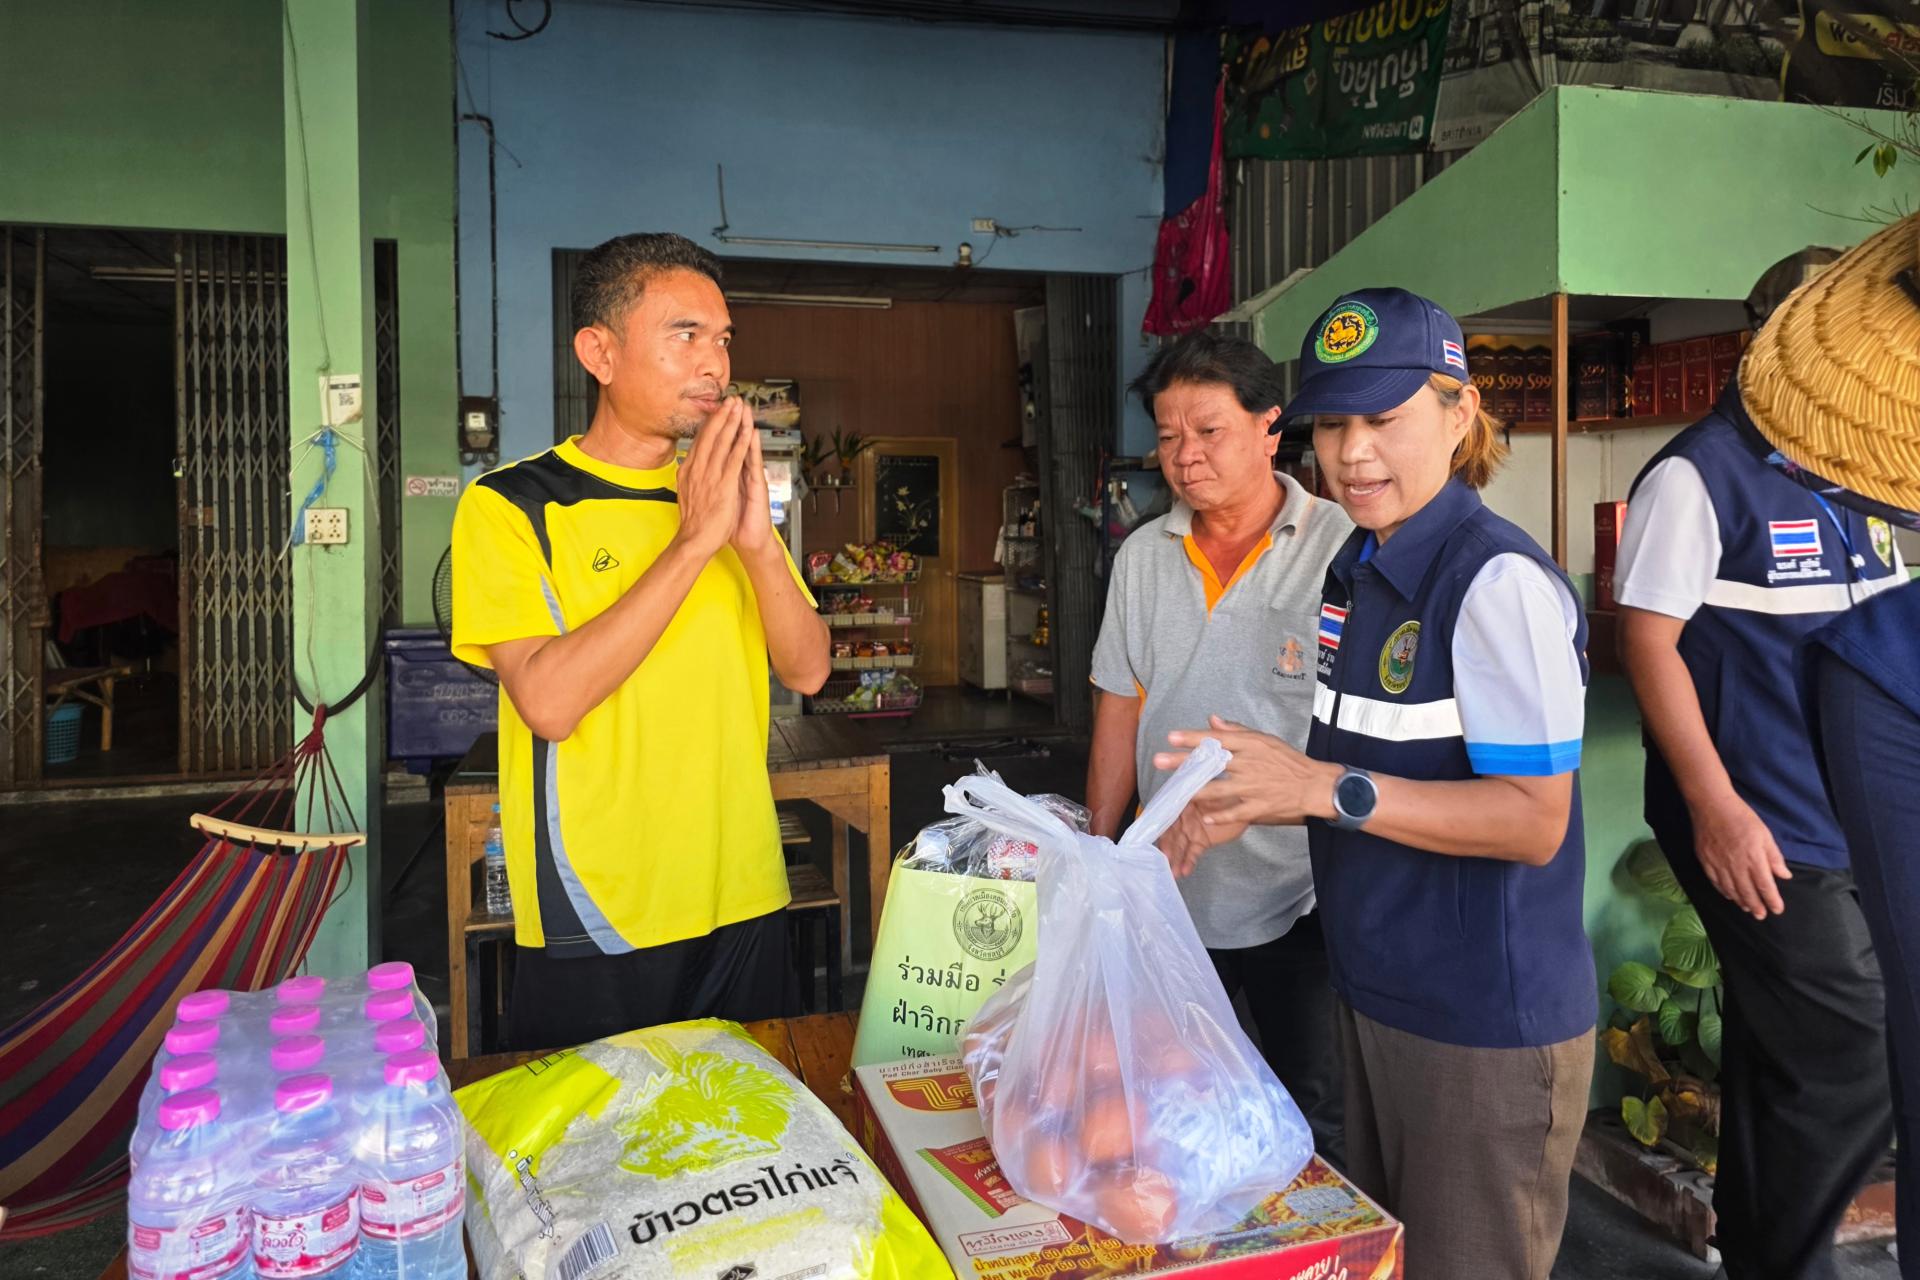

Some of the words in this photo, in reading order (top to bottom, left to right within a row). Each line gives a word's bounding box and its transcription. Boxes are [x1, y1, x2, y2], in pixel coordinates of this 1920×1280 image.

[897, 955, 980, 992] ร่วมมือ
[627, 1158, 860, 1245] ข้าวตราไก่แจ้
[966, 1229, 1044, 1249] หมึกแดง
[974, 1251, 1040, 1272] น้ำหนักสุทธิ
[1043, 1248, 1060, 1259] 60
[1064, 1244, 1089, 1257] กรัม
[1101, 1238, 1120, 1250] 30
[1008, 1263, 1054, 1279] Weight
[1057, 1259, 1075, 1270] 60
[1125, 1247, 1157, 1258] Bags
